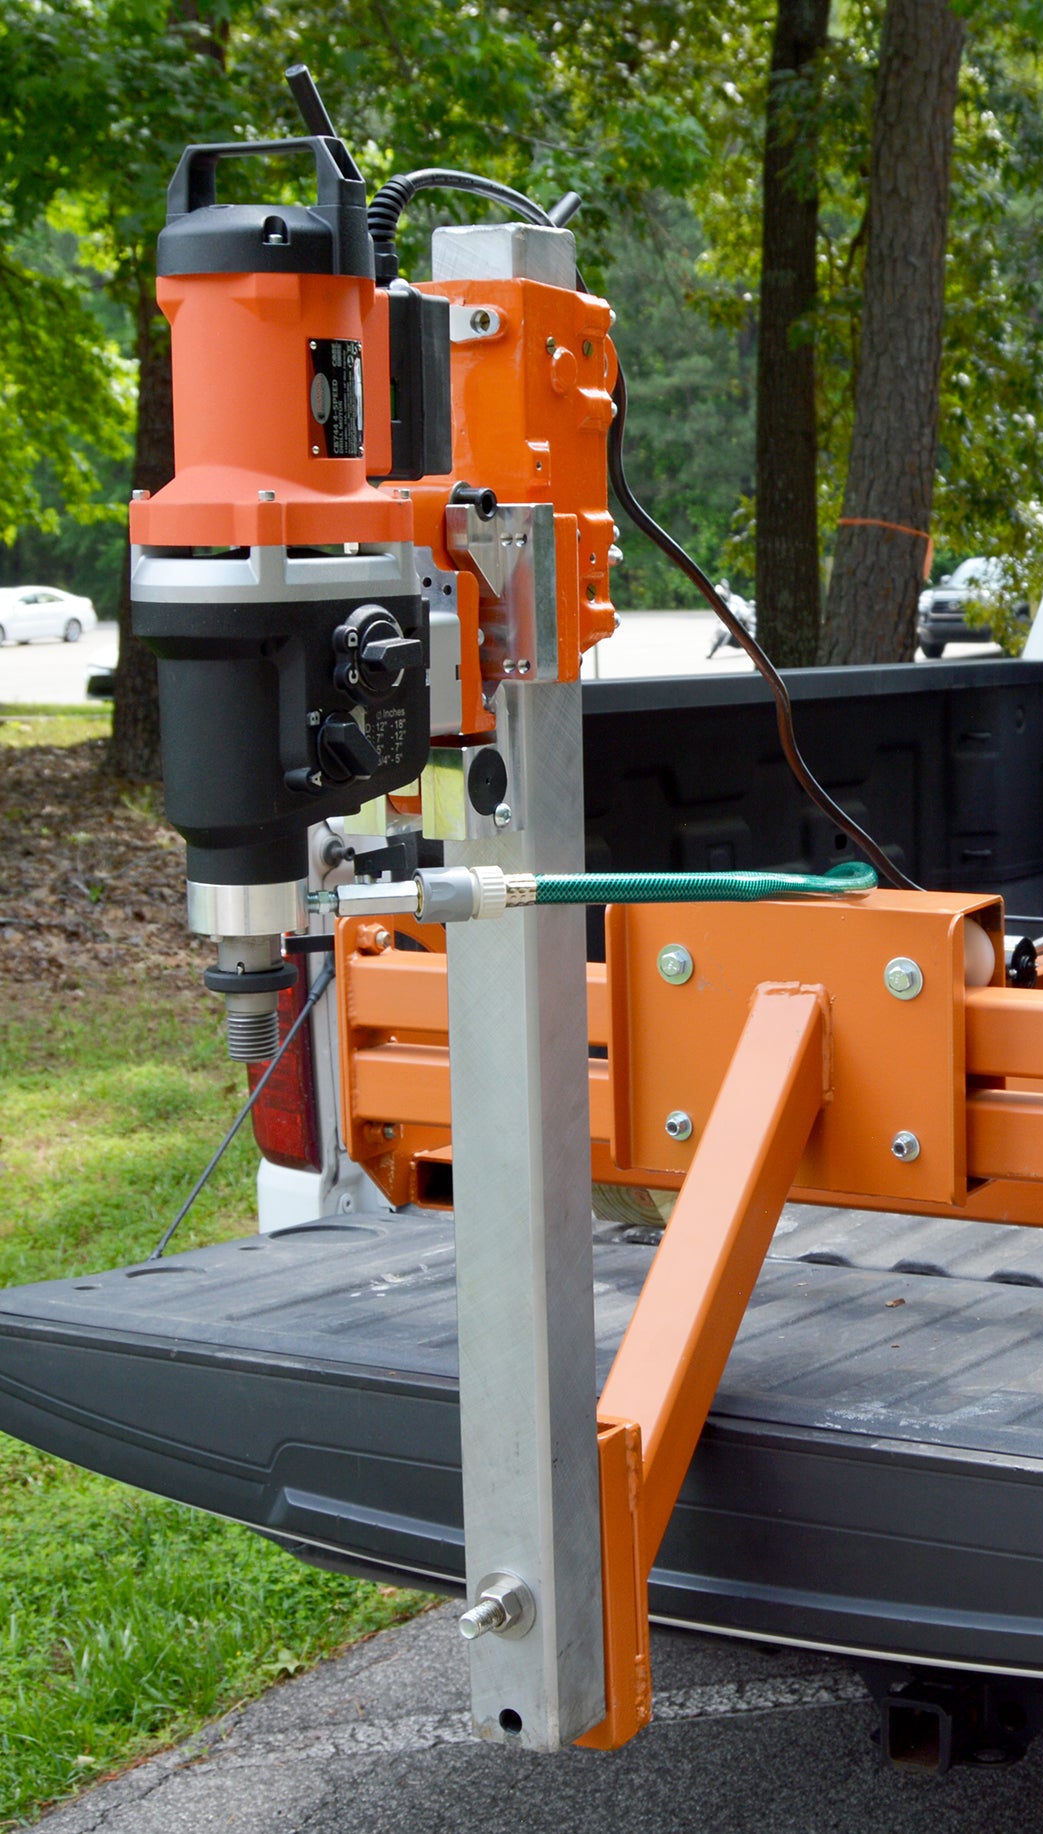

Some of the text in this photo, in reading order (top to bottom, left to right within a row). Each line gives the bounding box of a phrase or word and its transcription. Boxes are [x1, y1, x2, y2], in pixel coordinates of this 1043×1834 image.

[348, 632, 358, 647] D
[383, 708, 405, 718] Inches
[310, 770, 322, 787] A
